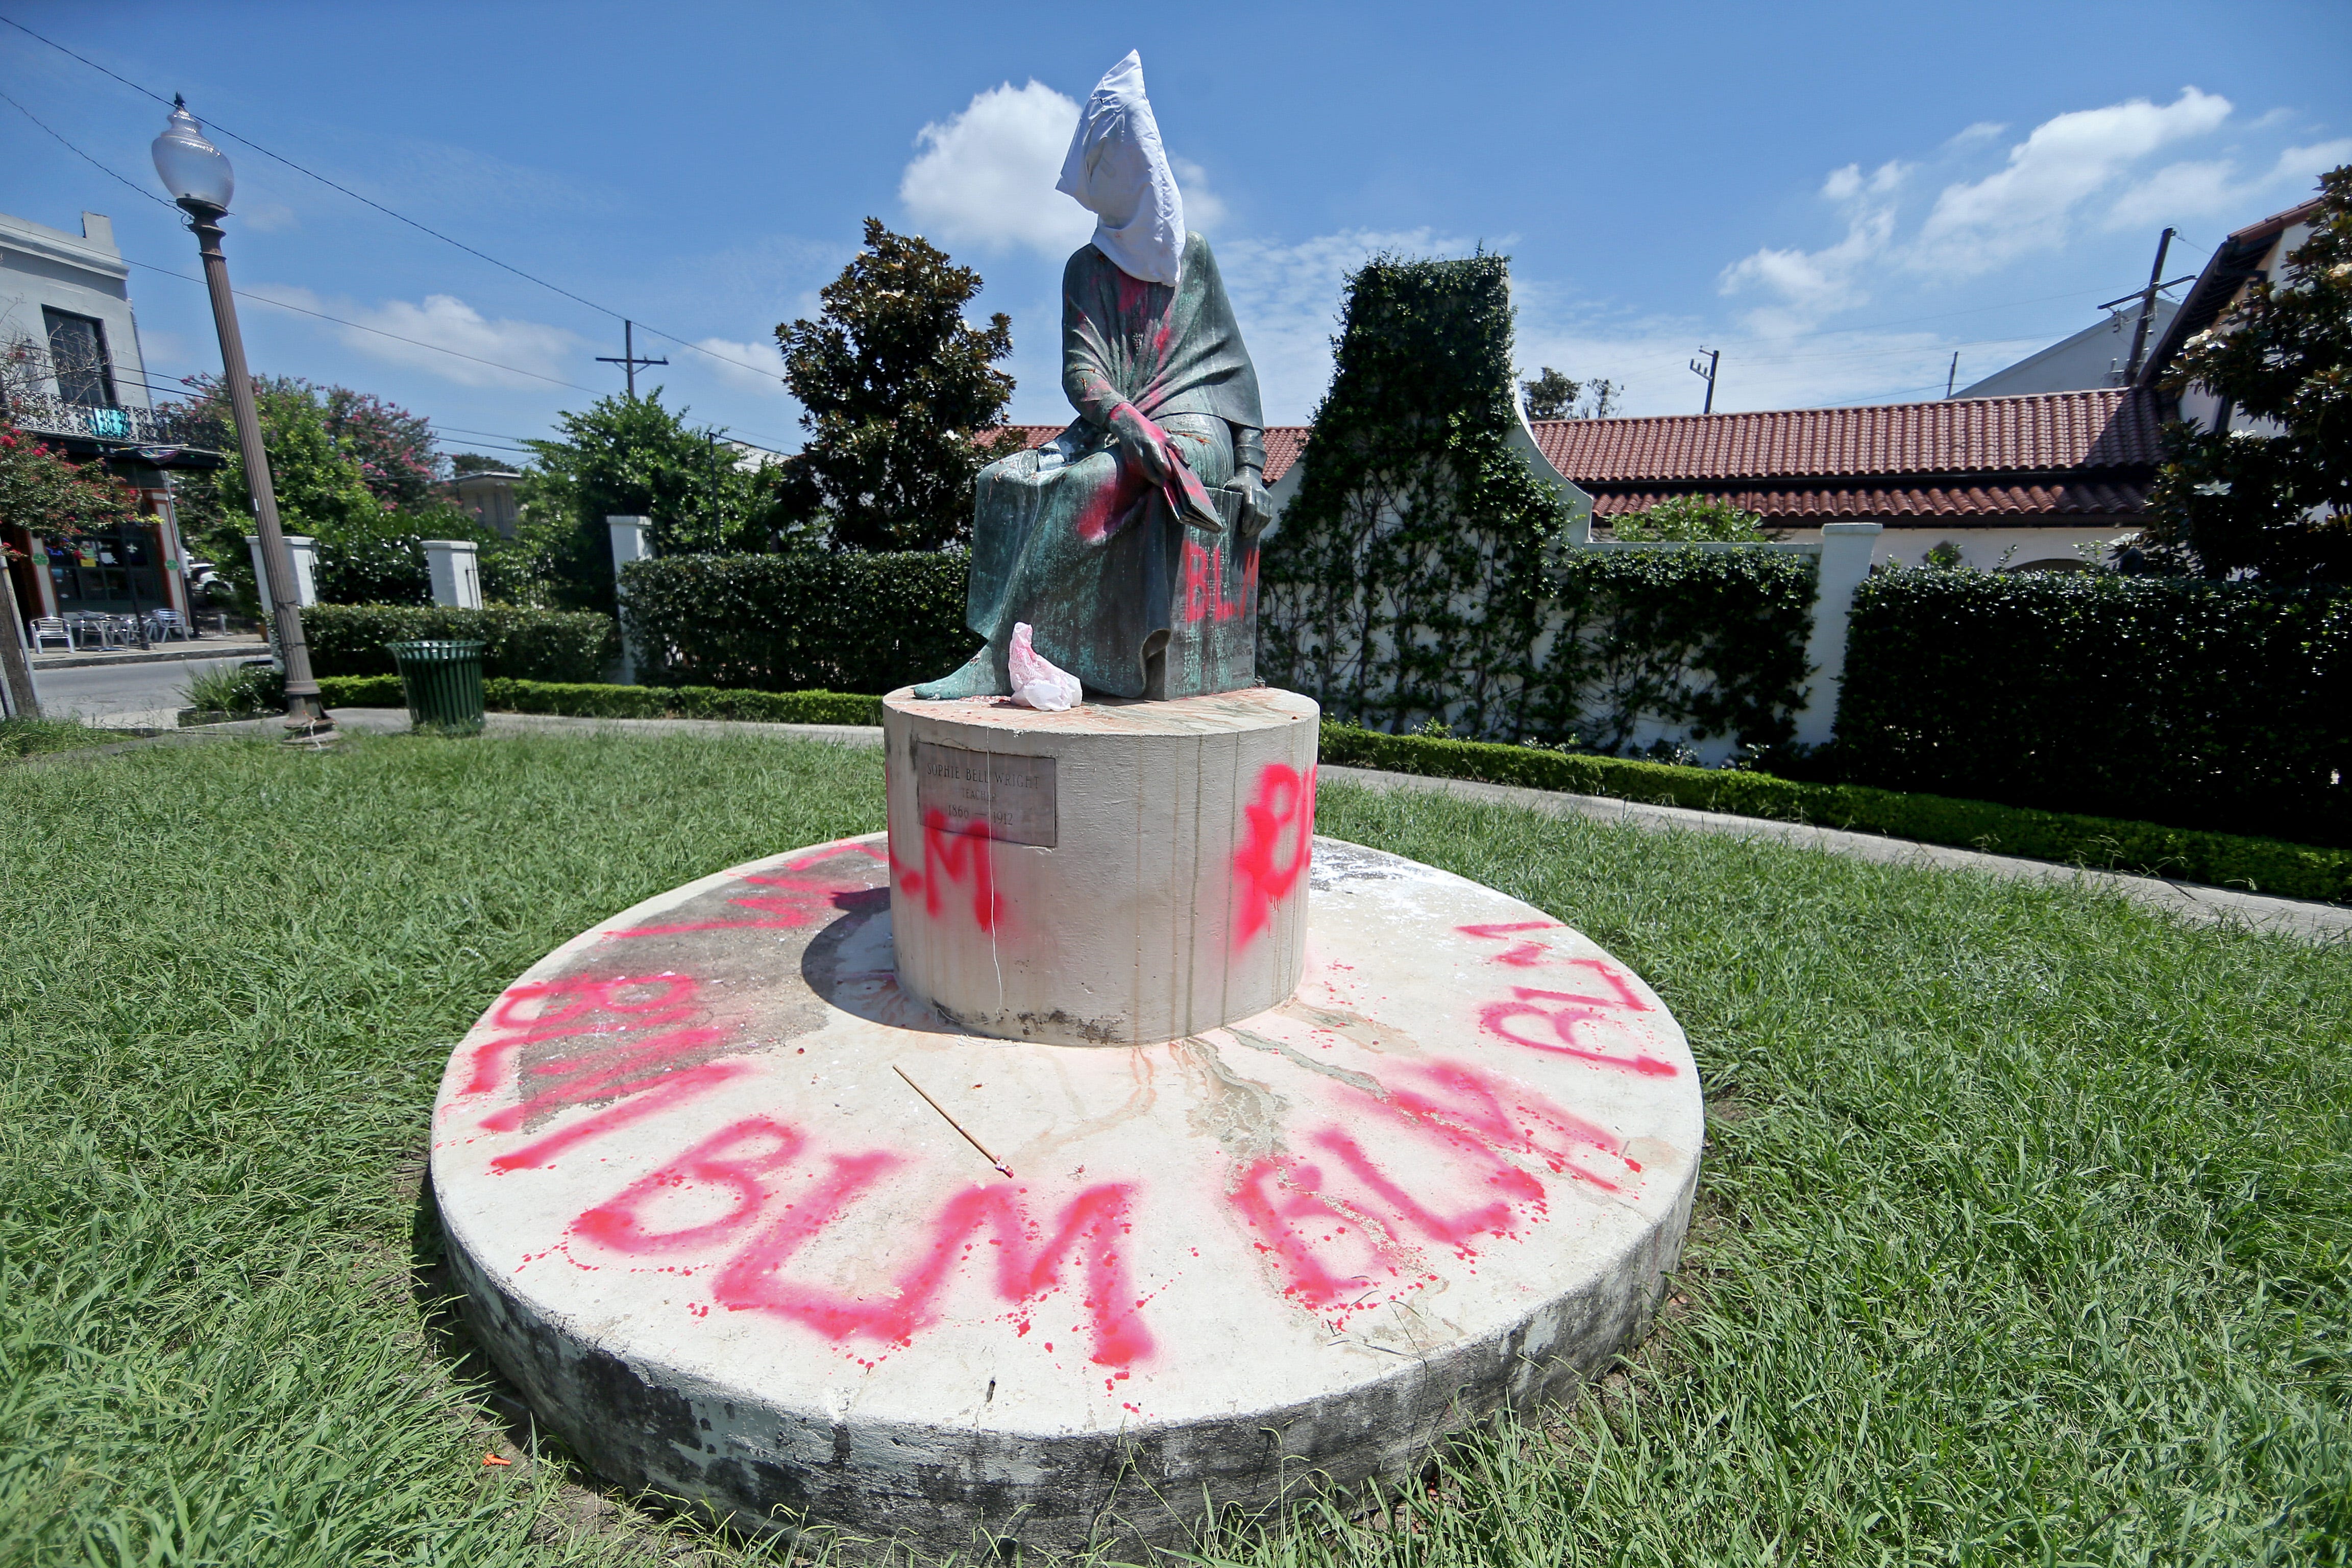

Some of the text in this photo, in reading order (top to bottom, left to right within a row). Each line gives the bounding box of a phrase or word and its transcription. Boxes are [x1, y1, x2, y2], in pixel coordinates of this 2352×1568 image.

[927, 763, 1040, 789] SOPHIE BELL WRIGHT
[962, 788, 997, 802] TEACHER
[993, 811, 1014, 826] 1912
[567, 1115, 1159, 1368] BLM
